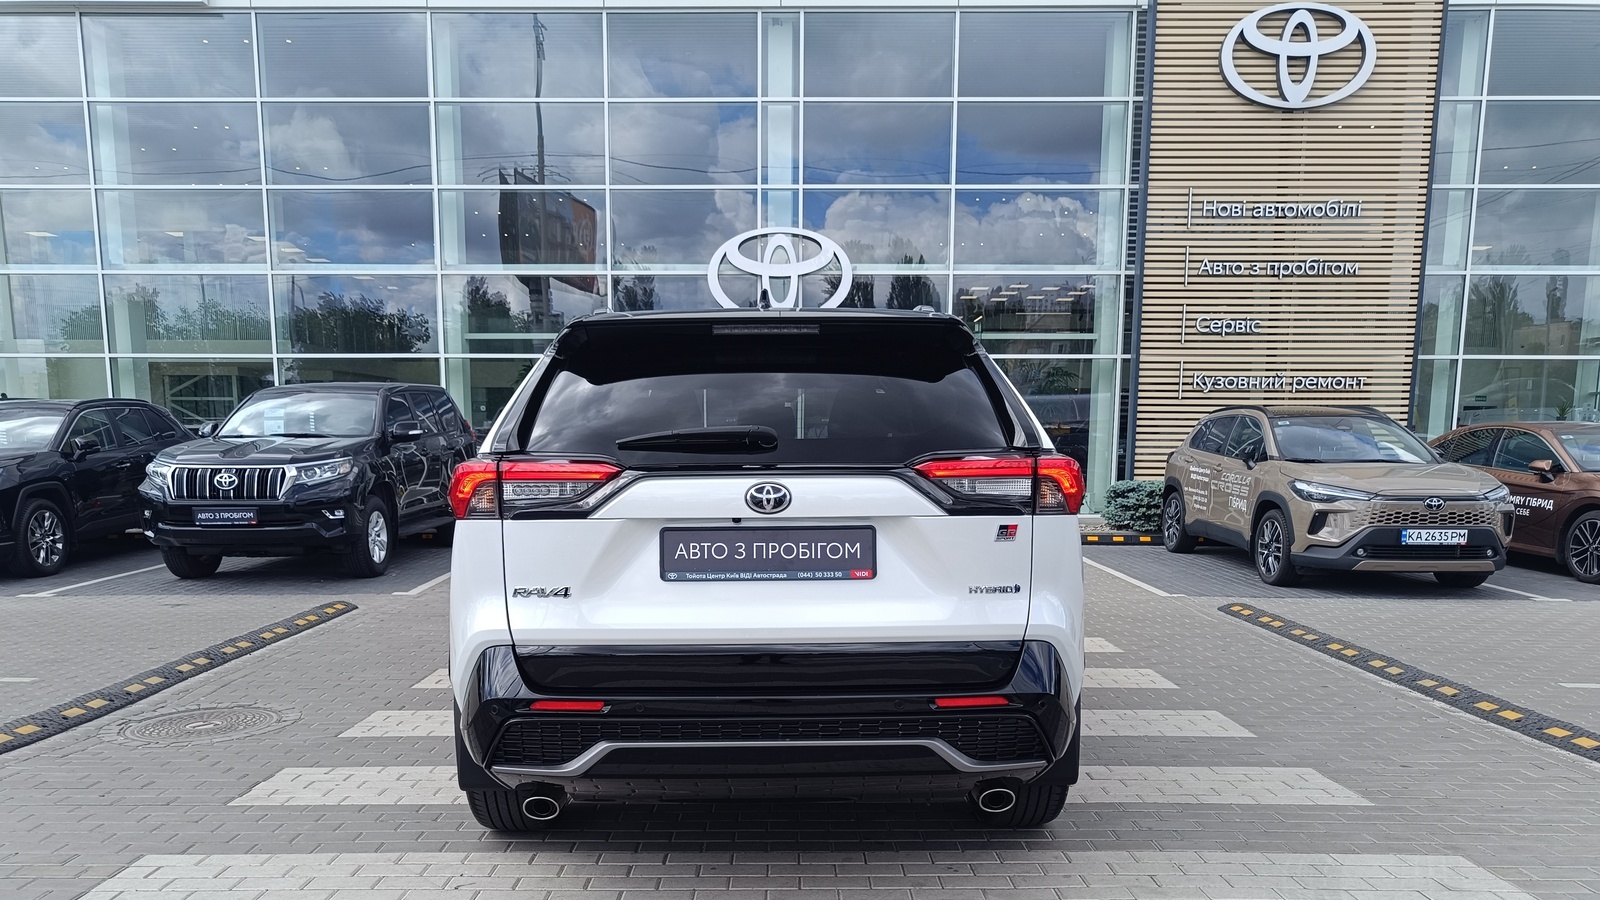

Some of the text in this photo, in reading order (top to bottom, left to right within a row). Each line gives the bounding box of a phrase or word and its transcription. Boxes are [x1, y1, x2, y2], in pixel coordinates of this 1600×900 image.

[1201, 199, 1363, 218] Нові автомобілі
[1197, 257, 1359, 280] Авто з пробігом
[1195, 316, 1262, 337] Сервіс
[1192, 372, 1367, 394] Кузовний ремонт
[1220, 472, 1252, 486] COROLLA
[1210, 480, 1250, 497] CROSS
[1508, 494, 1554, 511] MRY ГІБРИД
[674, 542, 728, 560] АВТО
[752, 542, 861, 560] ПРОБІГОМ
[797, 571, 813, 579] (044)
[512, 585, 572, 599] RAV4
[968, 585, 1013, 594] HYBRID
